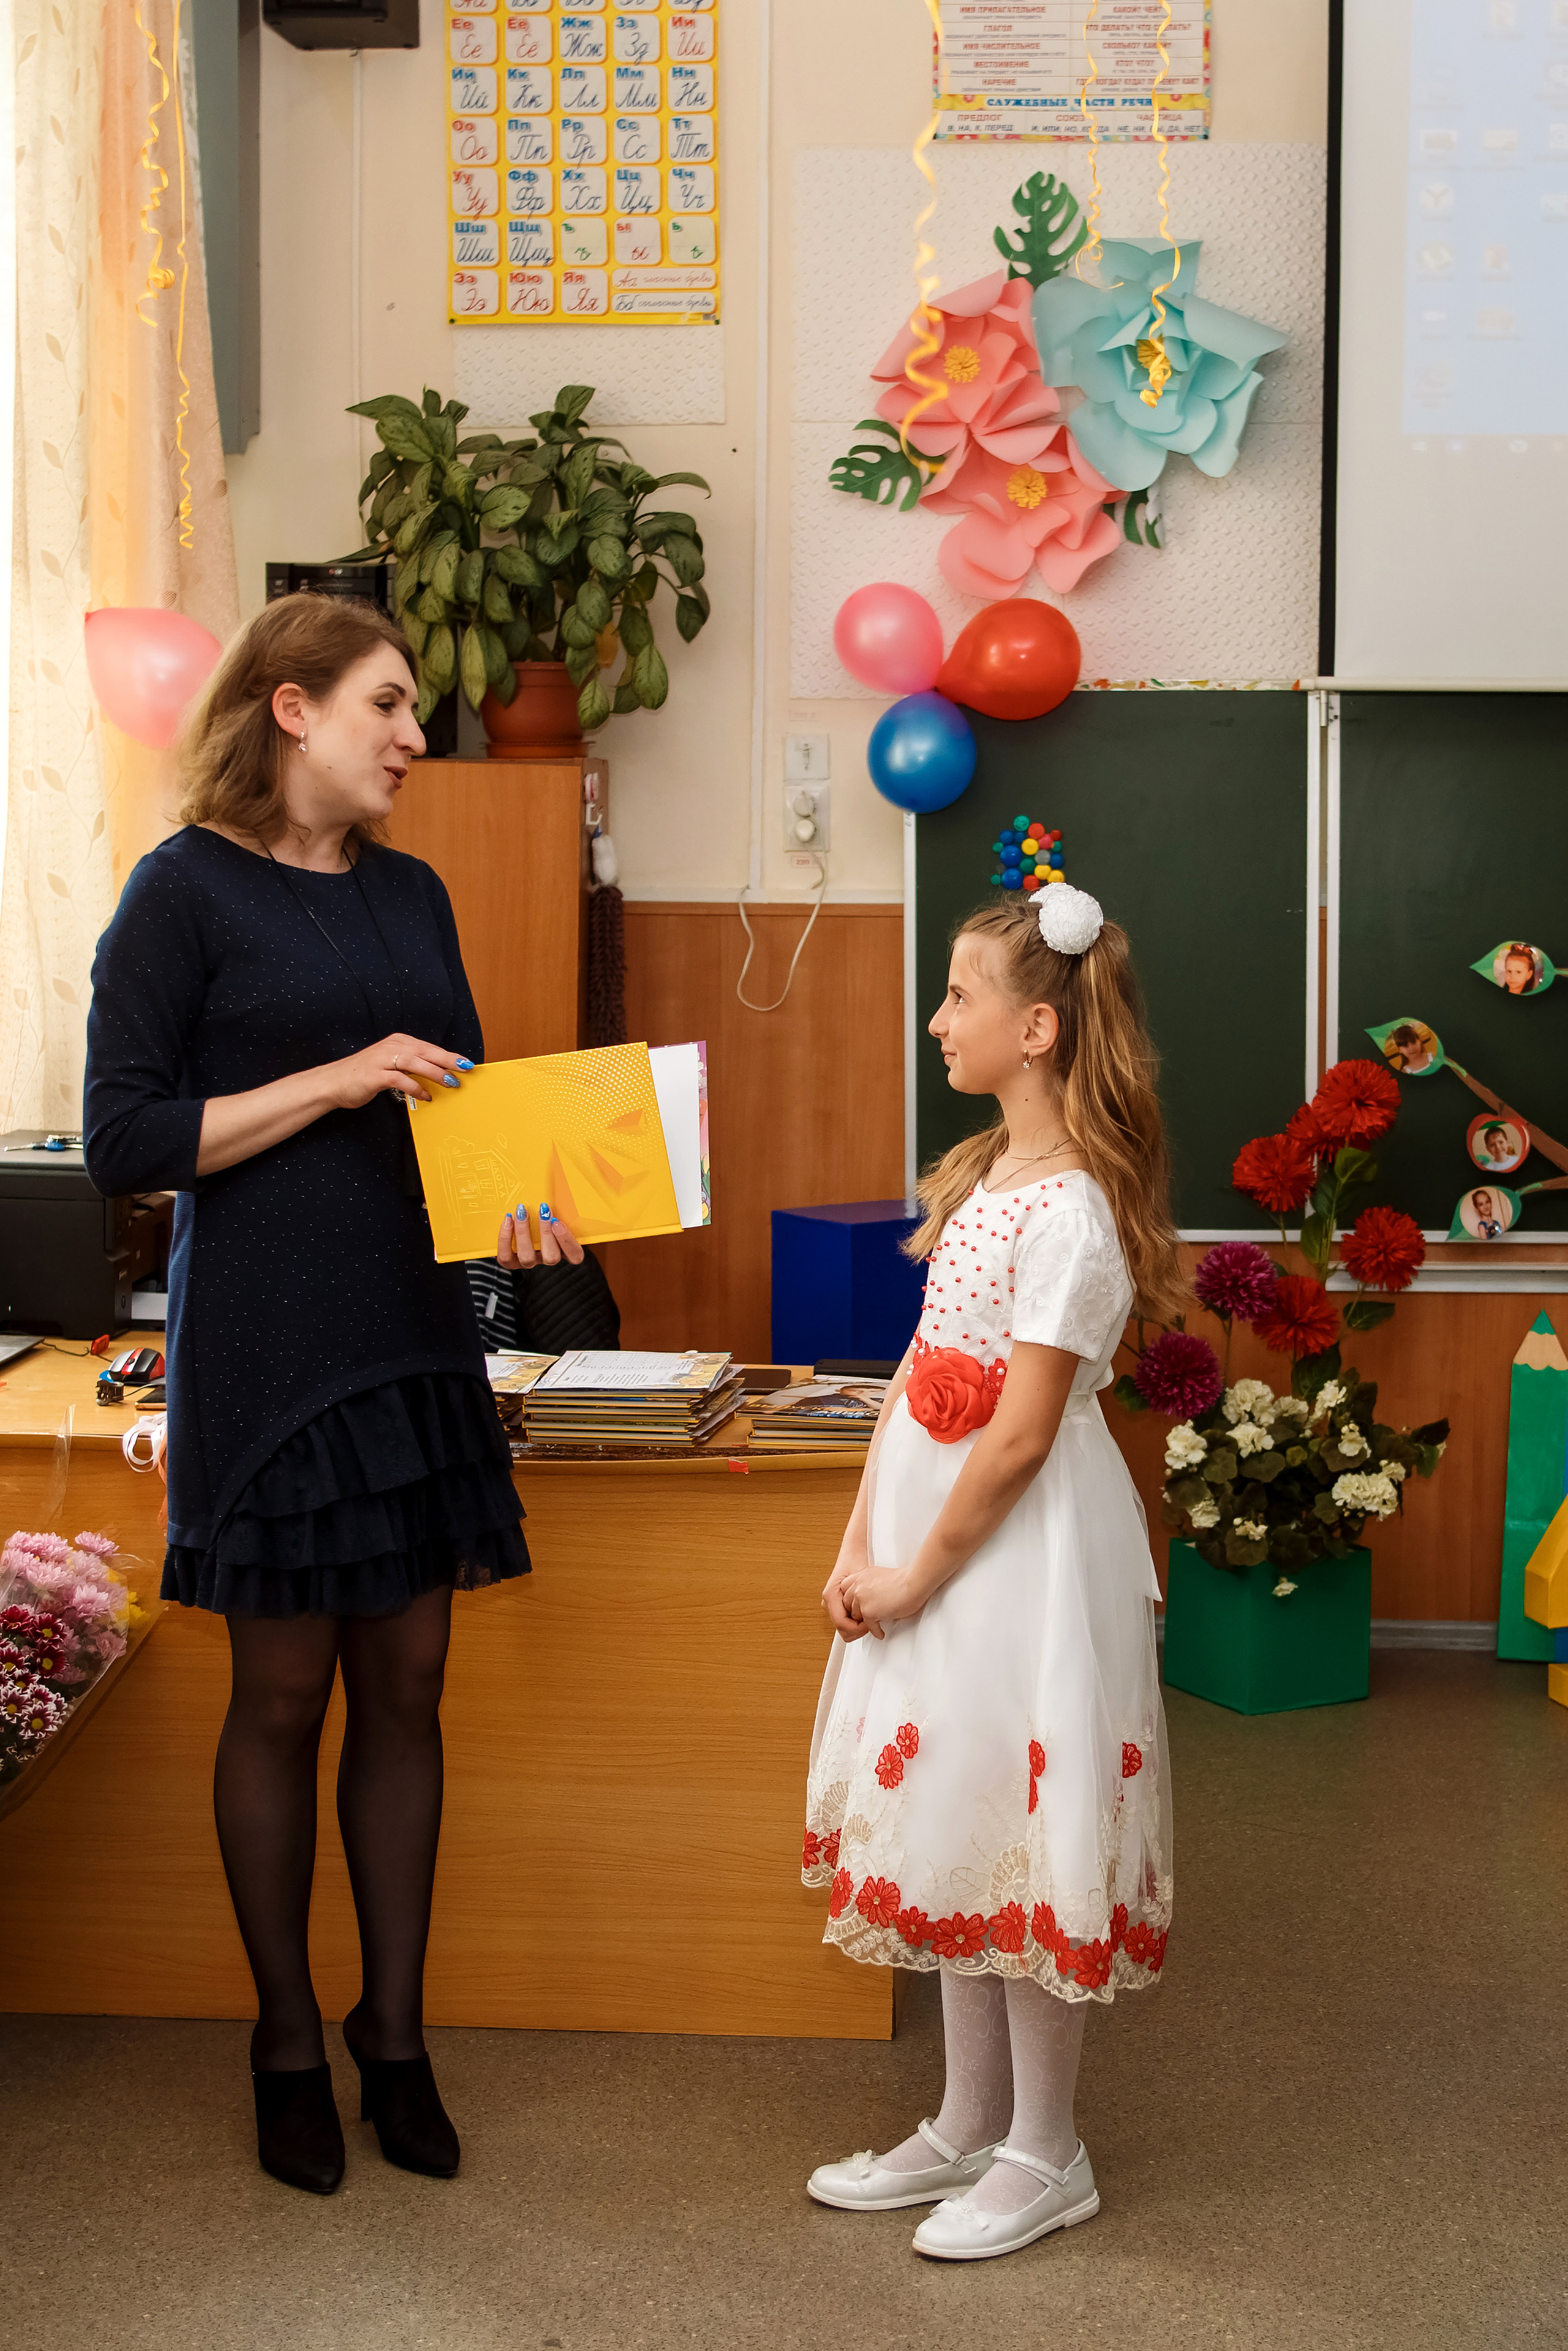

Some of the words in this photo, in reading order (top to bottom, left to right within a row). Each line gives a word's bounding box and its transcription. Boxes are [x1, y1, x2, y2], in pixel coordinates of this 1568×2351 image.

[451, 18, 472, 29] Ее
[560, 17, 591, 28] Жж
[616, 17, 636, 28] Зз
[671, 17, 695, 28] Ии
[461, 33, 481, 59] Ее
[560, 32, 603, 58] Жж
[624, 32, 649, 66] Зз
[677, 31, 705, 56] Ии
[451, 67, 475, 80] Йй
[507, 68, 527, 80] Кк
[560, 67, 583, 80] Лл
[616, 67, 643, 78] Мм
[672, 67, 695, 78] Нн
[460, 84, 489, 109] Йй
[512, 84, 543, 109] Кк
[564, 83, 600, 108] Лл
[616, 83, 658, 108] Мм
[674, 81, 707, 107] Нн
[987, 98, 1068, 107] СЛУЖЕБНЫЕ
[1121, 98, 1152, 107] РЕЧИ
[451, 120, 473, 131] Оо
[508, 119, 529, 130] Пп
[561, 119, 582, 132] Рр
[616, 119, 637, 129] Сс
[671, 118, 692, 129] Тт
[460, 135, 489, 160] Оо
[510, 134, 549, 160] Пп
[567, 134, 596, 169] Рр
[622, 134, 647, 159] Сс
[671, 132, 710, 158] Тт
[453, 171, 472, 184] Уу
[508, 170, 537, 183] Фф
[562, 170, 583, 180] Хх
[616, 169, 640, 181] Цц
[672, 168, 695, 179] Чч
[565, 185, 602, 210] Хх
[620, 184, 654, 215] Цц
[680, 184, 706, 208] Чч
[462, 186, 488, 222] Уу
[511, 186, 546, 221] Фф
[454, 222, 485, 233] Шш
[508, 222, 540, 234] Щщ
[457, 237, 495, 262] Шш
[508, 236, 555, 267] Щщ
[453, 273, 475, 283] Ээ
[508, 272, 541, 283] Юю
[562, 272, 584, 283] Яя
[461, 288, 487, 311] Ээ
[510, 287, 550, 312] Юю
[567, 287, 600, 311] Яя
